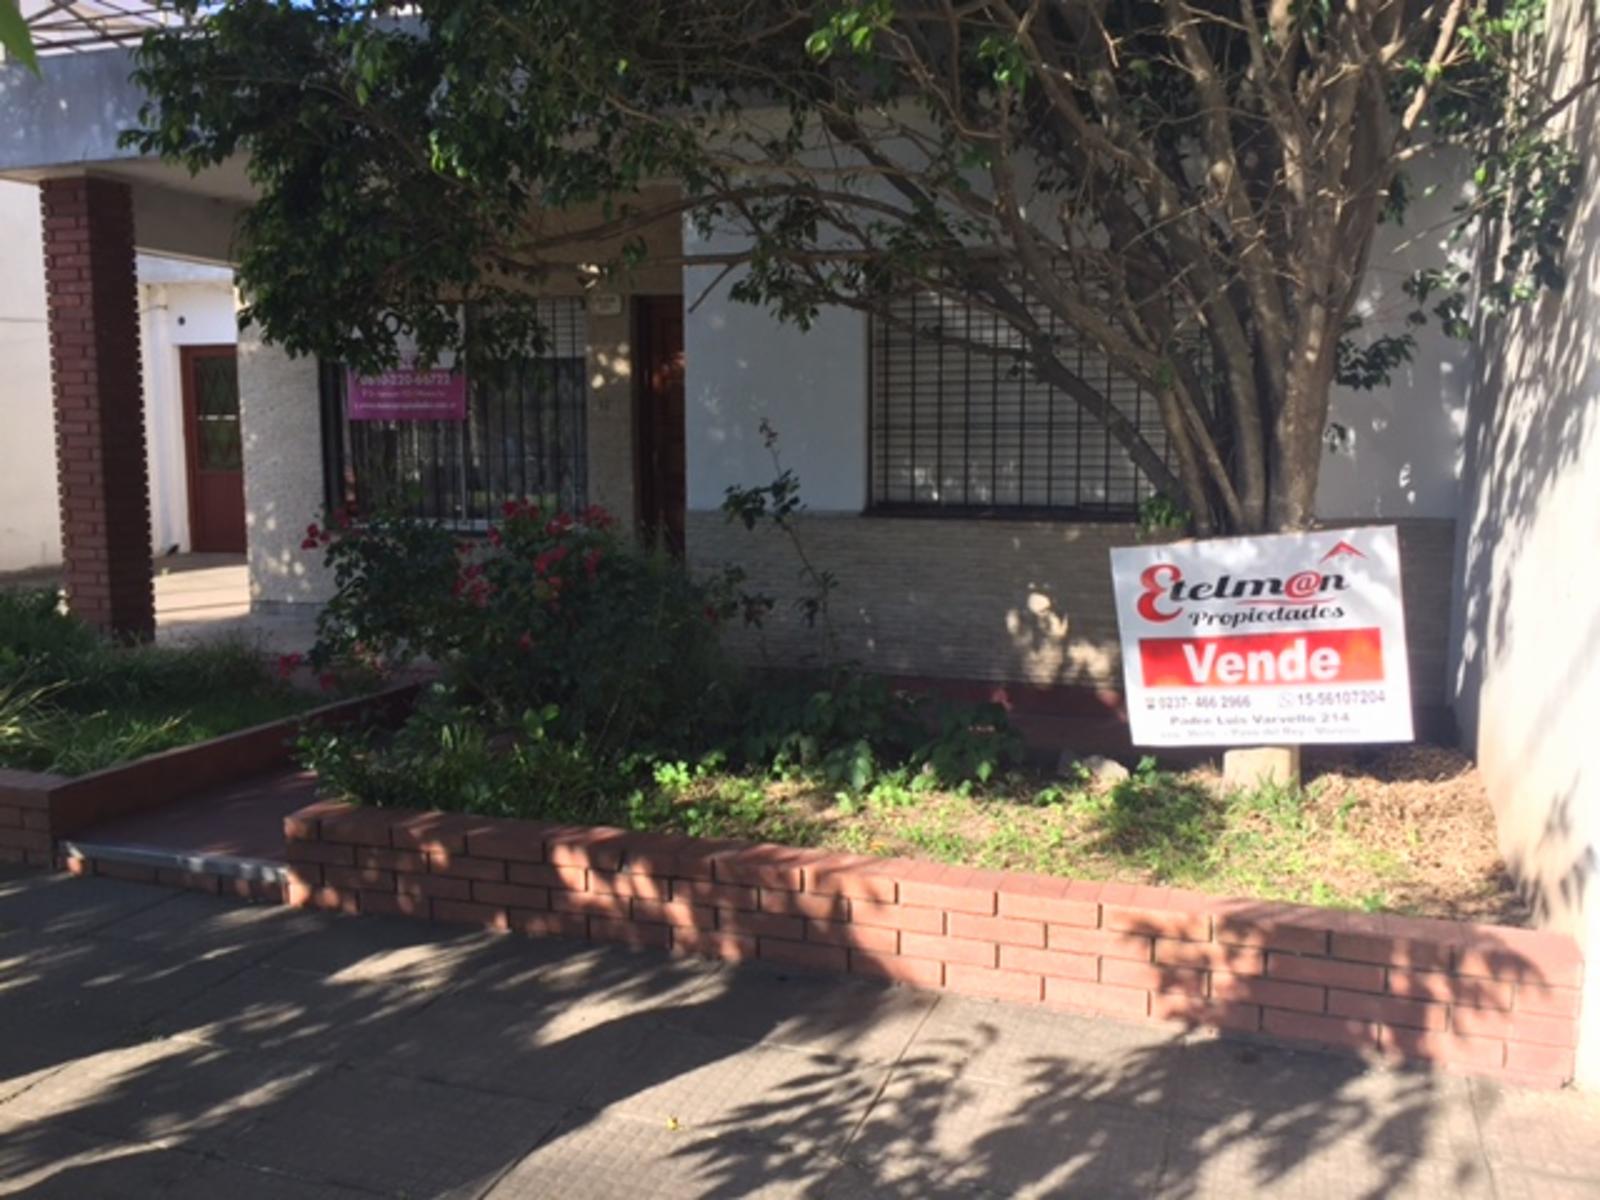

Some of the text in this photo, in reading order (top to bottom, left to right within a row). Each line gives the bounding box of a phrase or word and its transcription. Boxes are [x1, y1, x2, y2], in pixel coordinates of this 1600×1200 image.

[1136, 563, 1350, 623] Etelm@n
[1187, 604, 1346, 628] Propiedades
[1182, 638, 1342, 684] Vende
[1170, 715, 1212, 726] Padre
[1216, 714, 1248, 726] Luis
